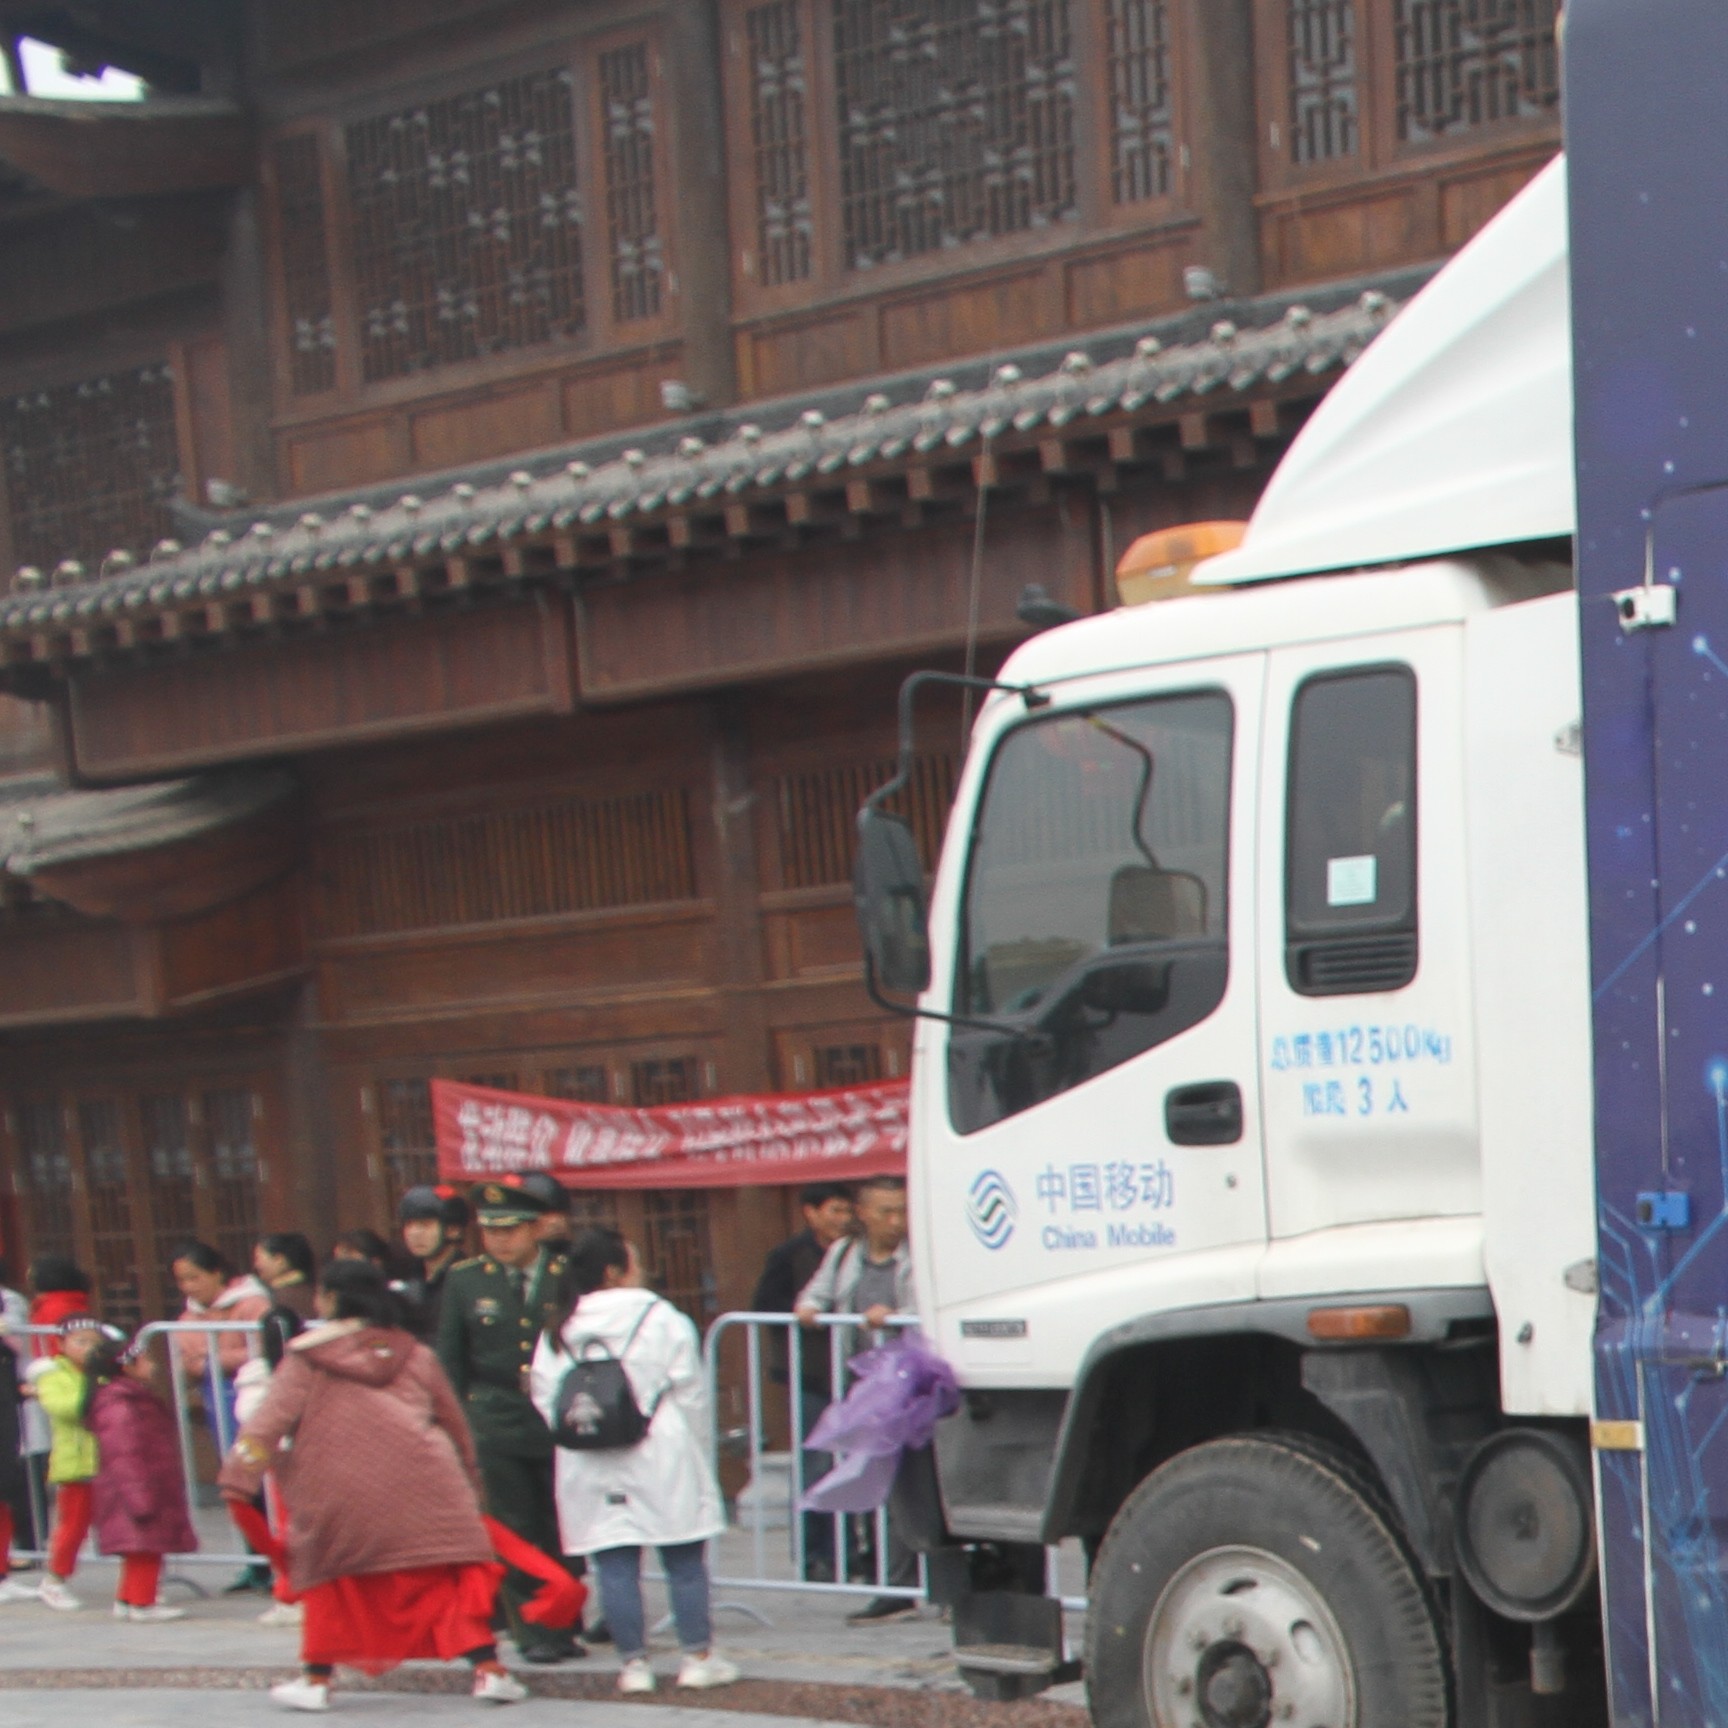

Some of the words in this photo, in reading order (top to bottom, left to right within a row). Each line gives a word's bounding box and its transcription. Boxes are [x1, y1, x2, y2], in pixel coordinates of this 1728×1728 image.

[1358, 1075, 1374, 1115] 3
[1387, 1078, 1408, 1113] 人
[1035, 1157, 1175, 1214] 中国移动
[1041, 1224, 1098, 1251] China
[1106, 1222, 1176, 1248] Mobile
